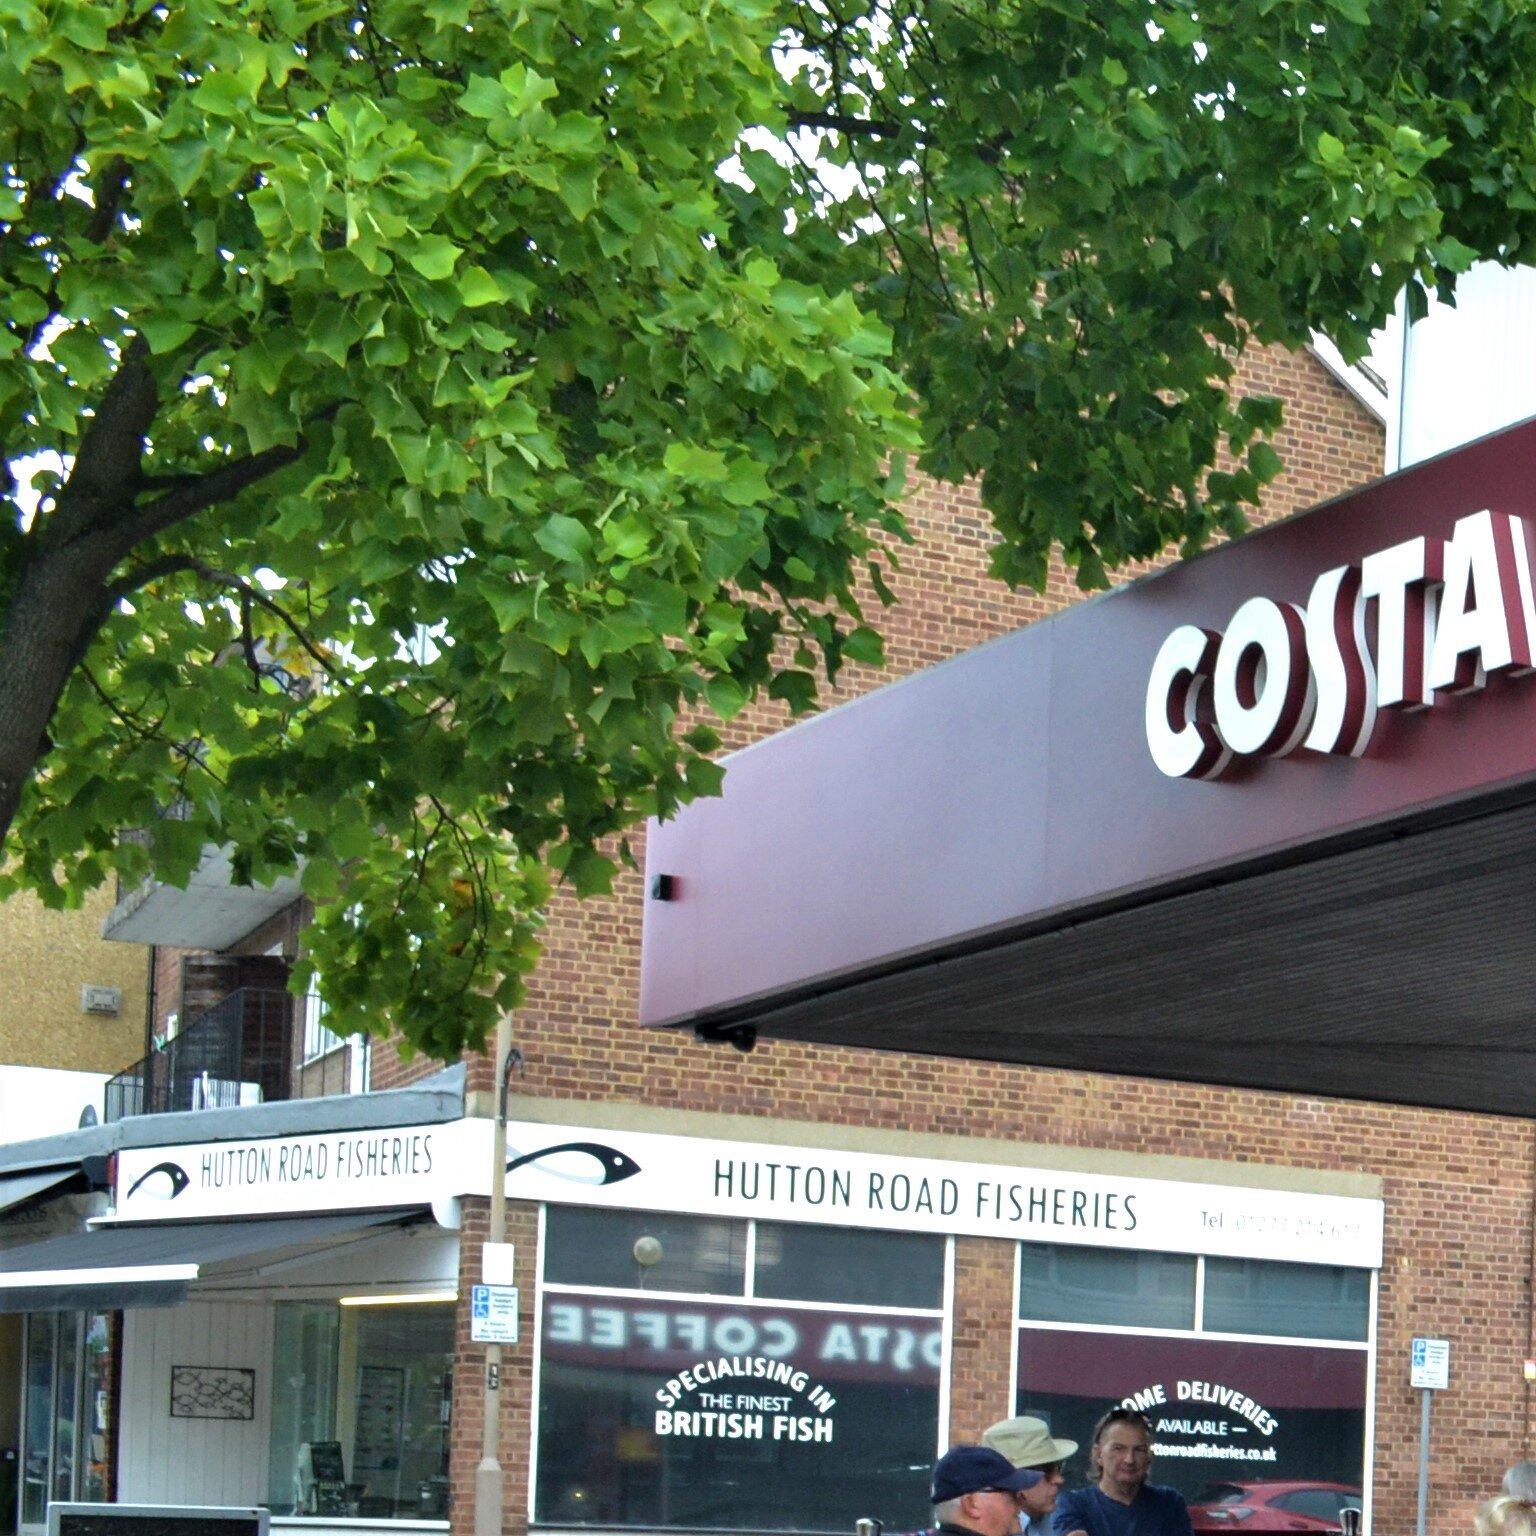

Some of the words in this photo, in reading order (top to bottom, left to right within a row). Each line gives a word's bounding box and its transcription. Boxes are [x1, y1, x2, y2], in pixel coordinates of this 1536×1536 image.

[201, 1147, 271, 1188] HUTTON
[279, 1143, 328, 1182] ROAD
[336, 1135, 433, 1178] FISHERIES
[713, 1159, 851, 1208] HUTTON
[868, 1171, 959, 1216] ROAD
[977, 1182, 1138, 1231] FISHERIES
[655, 1356, 809, 1408] SPECIALISING
[807, 1385, 836, 1413] IN
[698, 1393, 733, 1409] THE
[737, 1395, 792, 1412] FINEST
[1114, 1384, 1167, 1412] OME
[1176, 1381, 1279, 1436] DELIVERIES
[655, 1410, 763, 1439] BRITISH
[773, 1416, 833, 1443] FISH
[1155, 1418, 1229, 1436] AVAILABLE
